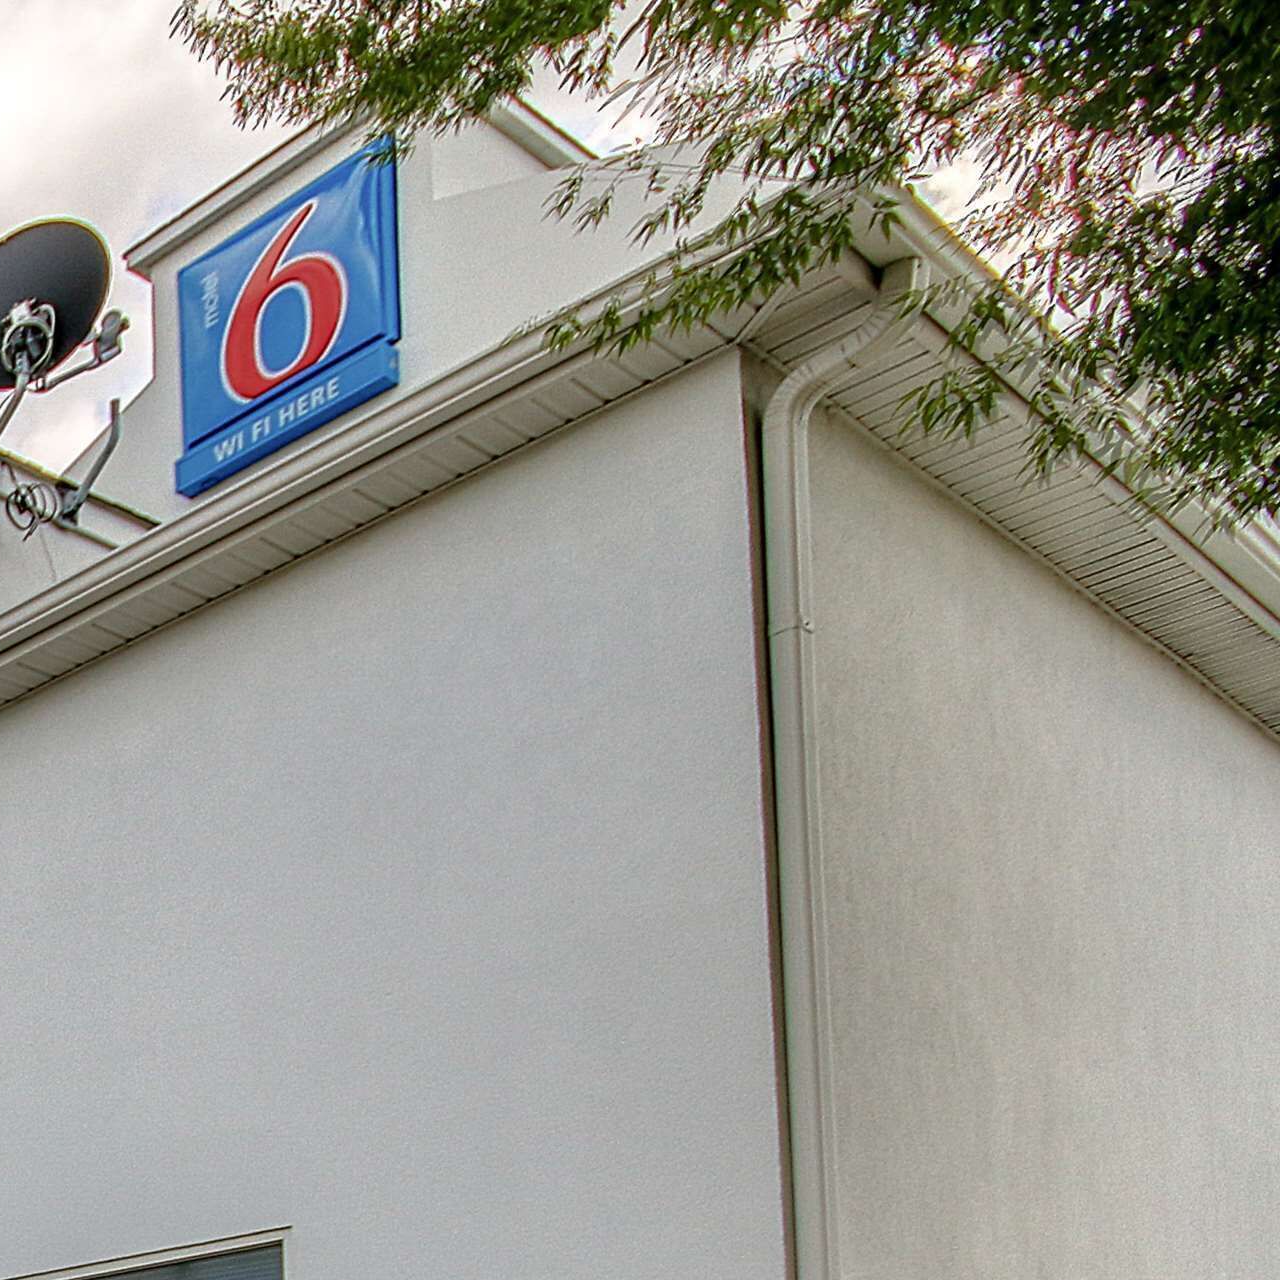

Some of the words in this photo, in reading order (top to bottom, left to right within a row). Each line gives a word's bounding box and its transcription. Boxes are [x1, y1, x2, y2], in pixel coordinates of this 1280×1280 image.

[221, 200, 348, 404] 6
[213, 432, 244, 462] WI
[252, 416, 271, 443] FI
[278, 377, 340, 427] HERE
